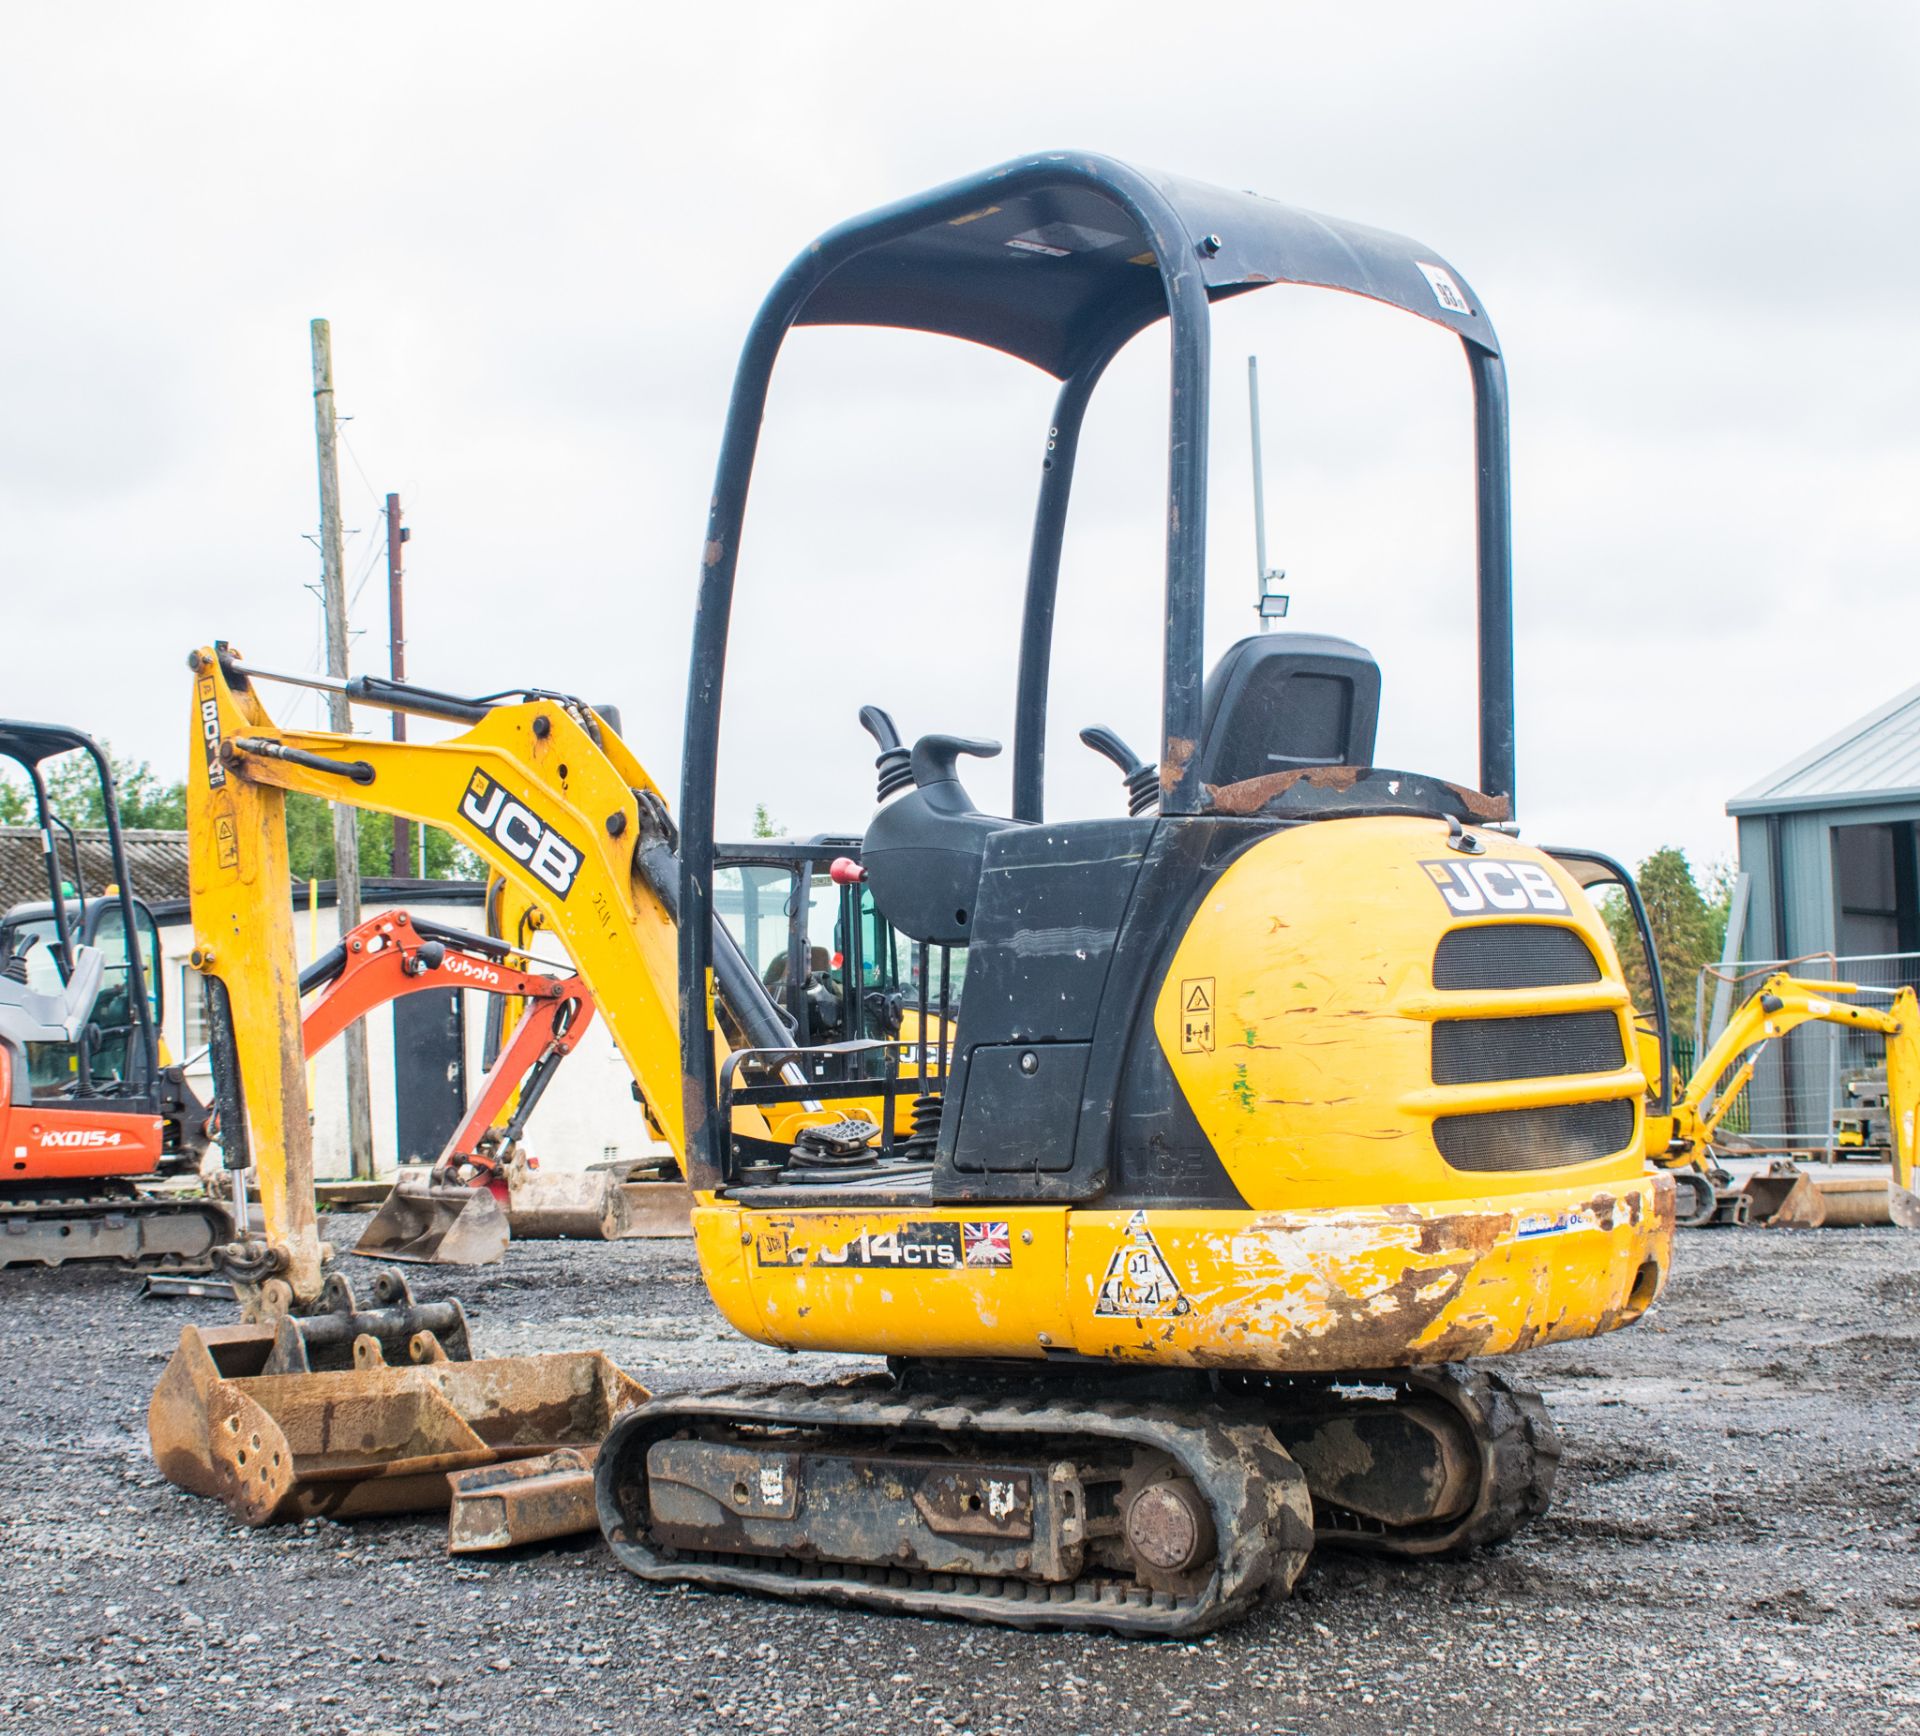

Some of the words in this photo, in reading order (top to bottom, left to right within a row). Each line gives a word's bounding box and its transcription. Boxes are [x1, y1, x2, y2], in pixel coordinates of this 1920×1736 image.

[463, 787, 578, 893] JCB
[1442, 861, 1567, 911] JCB
[442, 955, 499, 985] Kubota
